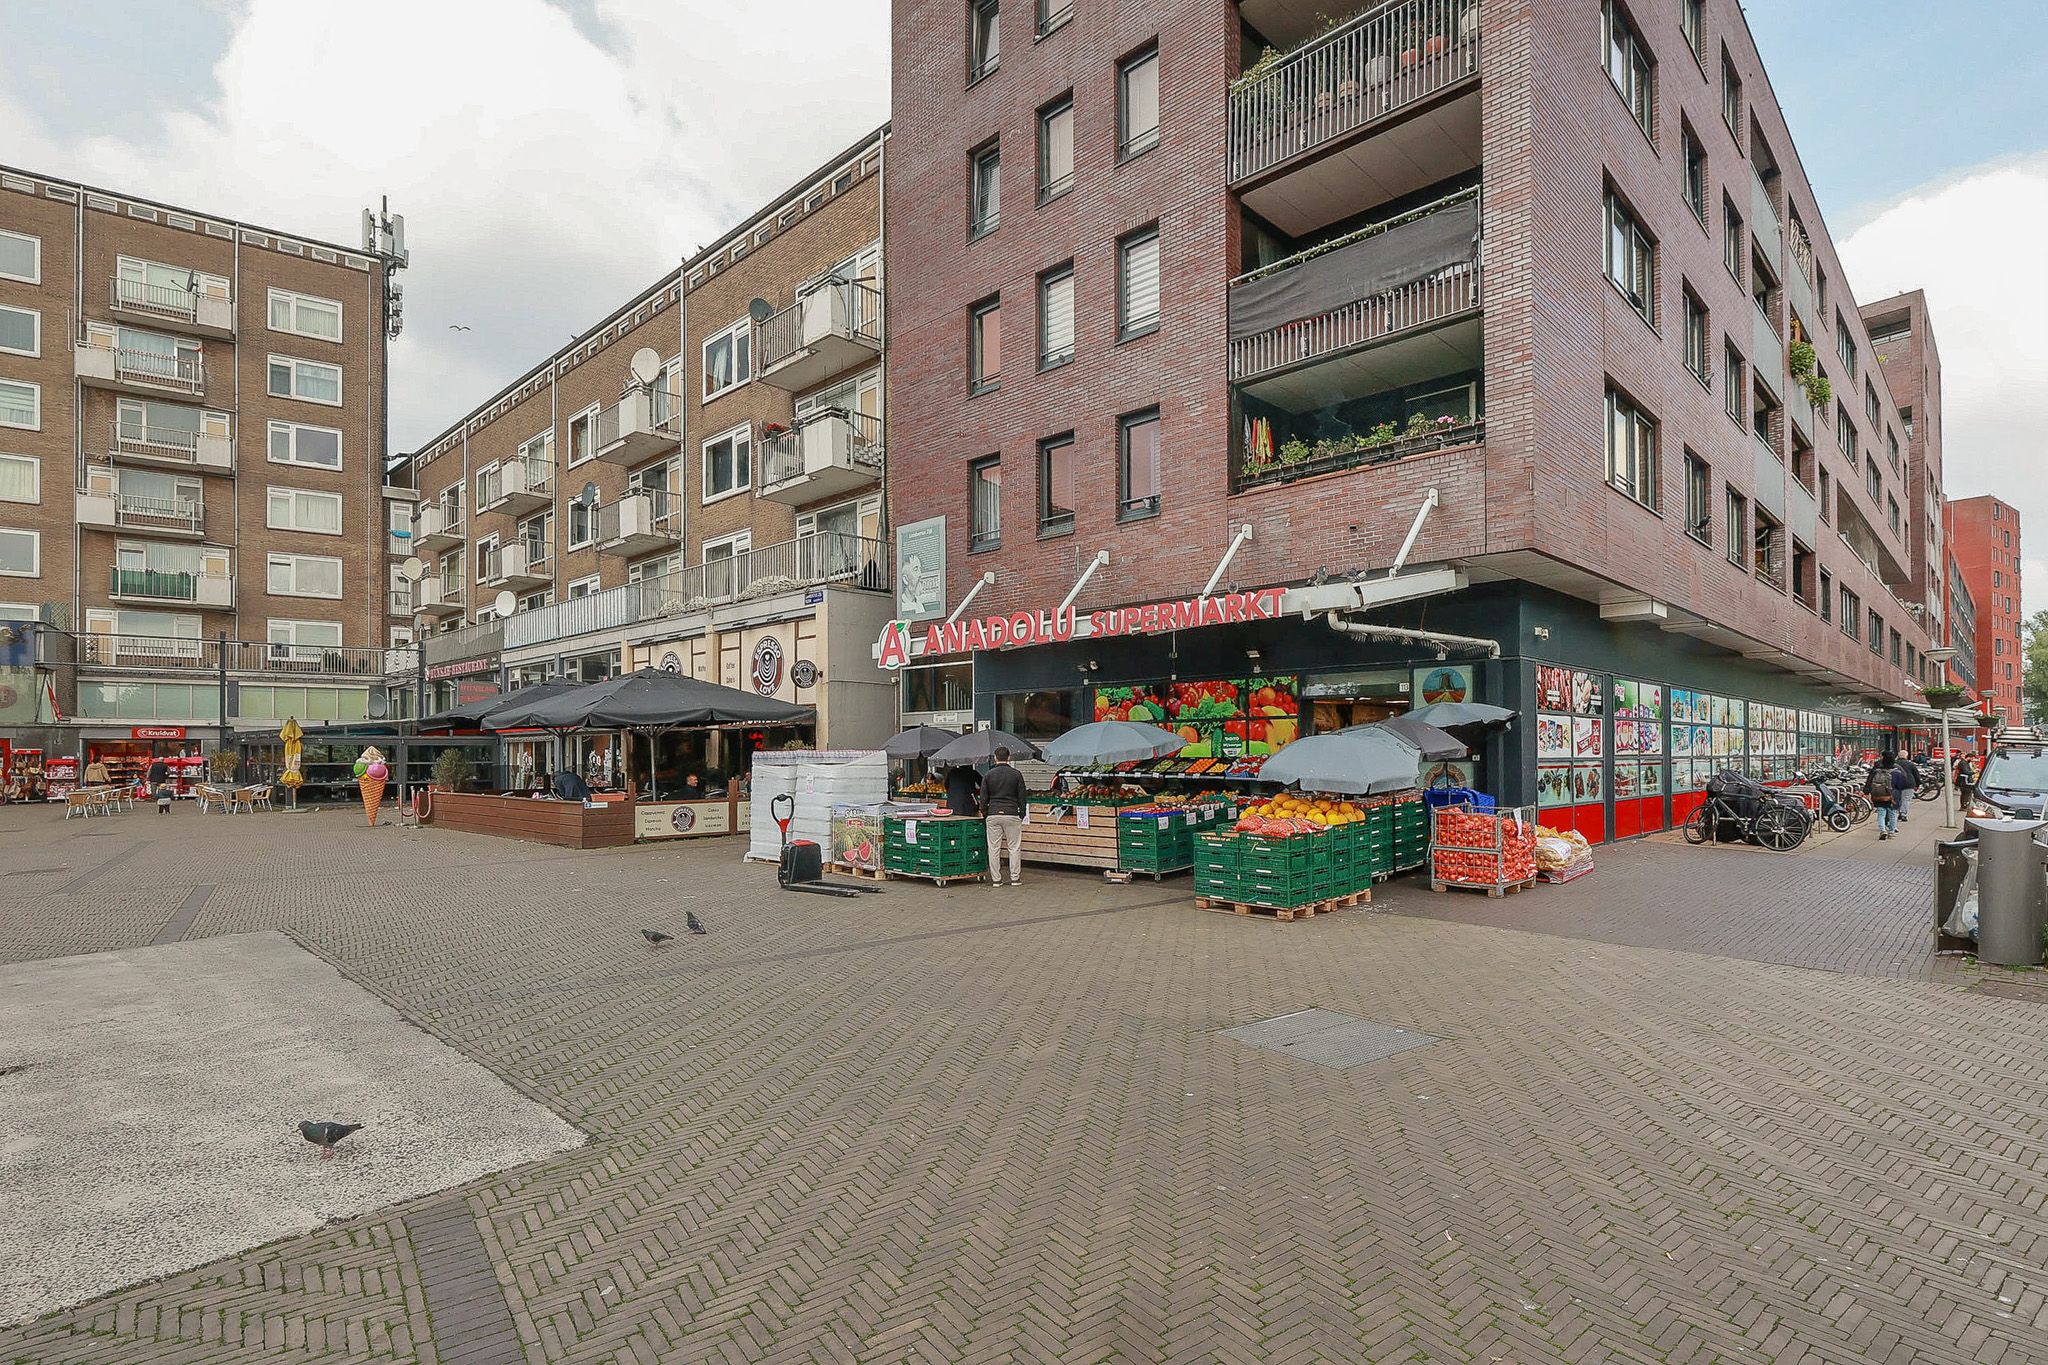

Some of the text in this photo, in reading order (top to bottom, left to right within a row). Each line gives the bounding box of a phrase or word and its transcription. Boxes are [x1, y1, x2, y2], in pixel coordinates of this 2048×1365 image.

[922, 587, 1288, 656] ANADOLU SUPERMARKT
[754, 640, 781, 660] ESPRESSO
[759, 683, 776, 694] LOVE
